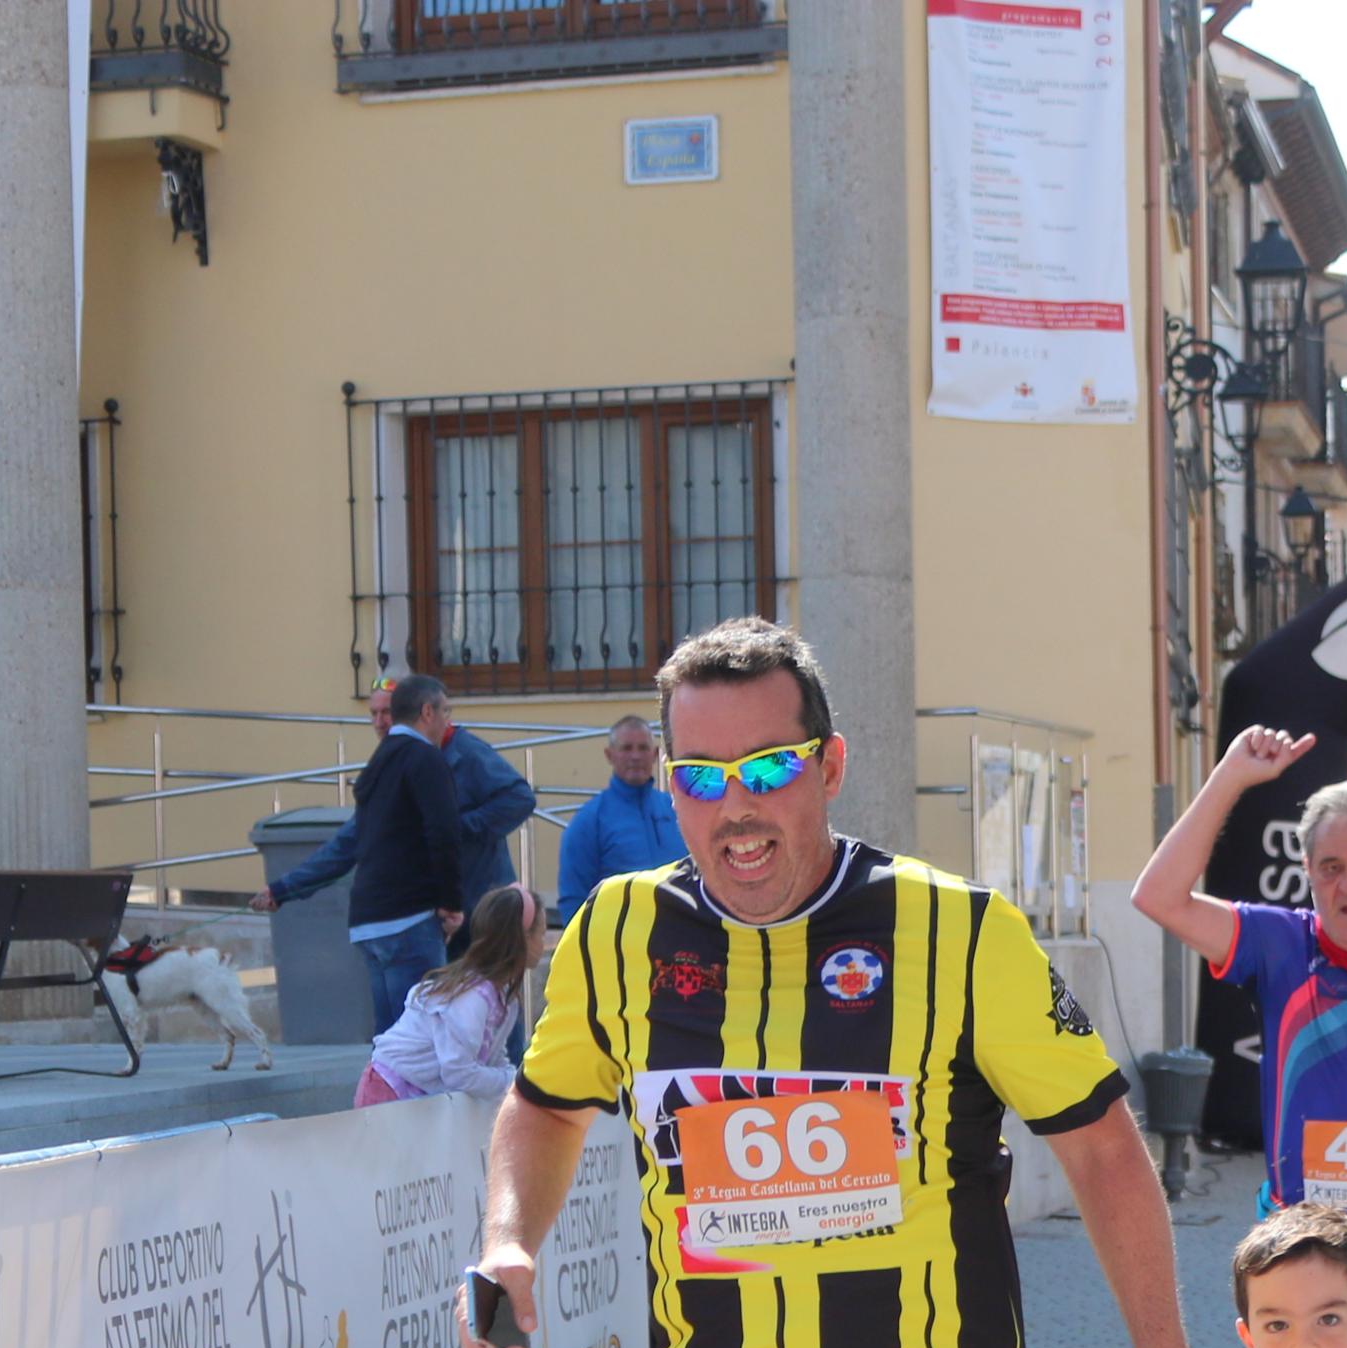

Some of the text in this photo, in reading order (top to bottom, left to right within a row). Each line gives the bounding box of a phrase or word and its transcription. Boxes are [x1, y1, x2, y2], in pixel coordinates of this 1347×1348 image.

[1093, 8, 1112, 69] 202
[723, 1102, 848, 1182] 66
[708, 1184, 746, 1200] Legua
[750, 1178, 820, 1197] Castellana
[821, 1173, 838, 1192] del
[841, 1172, 891, 1187] Cerrato
[798, 1196, 888, 1218] Eres nuestra
[727, 1210, 790, 1234] INTEGRA
[819, 1210, 875, 1229] energía
[98, 1222, 224, 1303] CLUB DEPORTIVO
[381, 1236, 440, 1312] ATLETISMO
